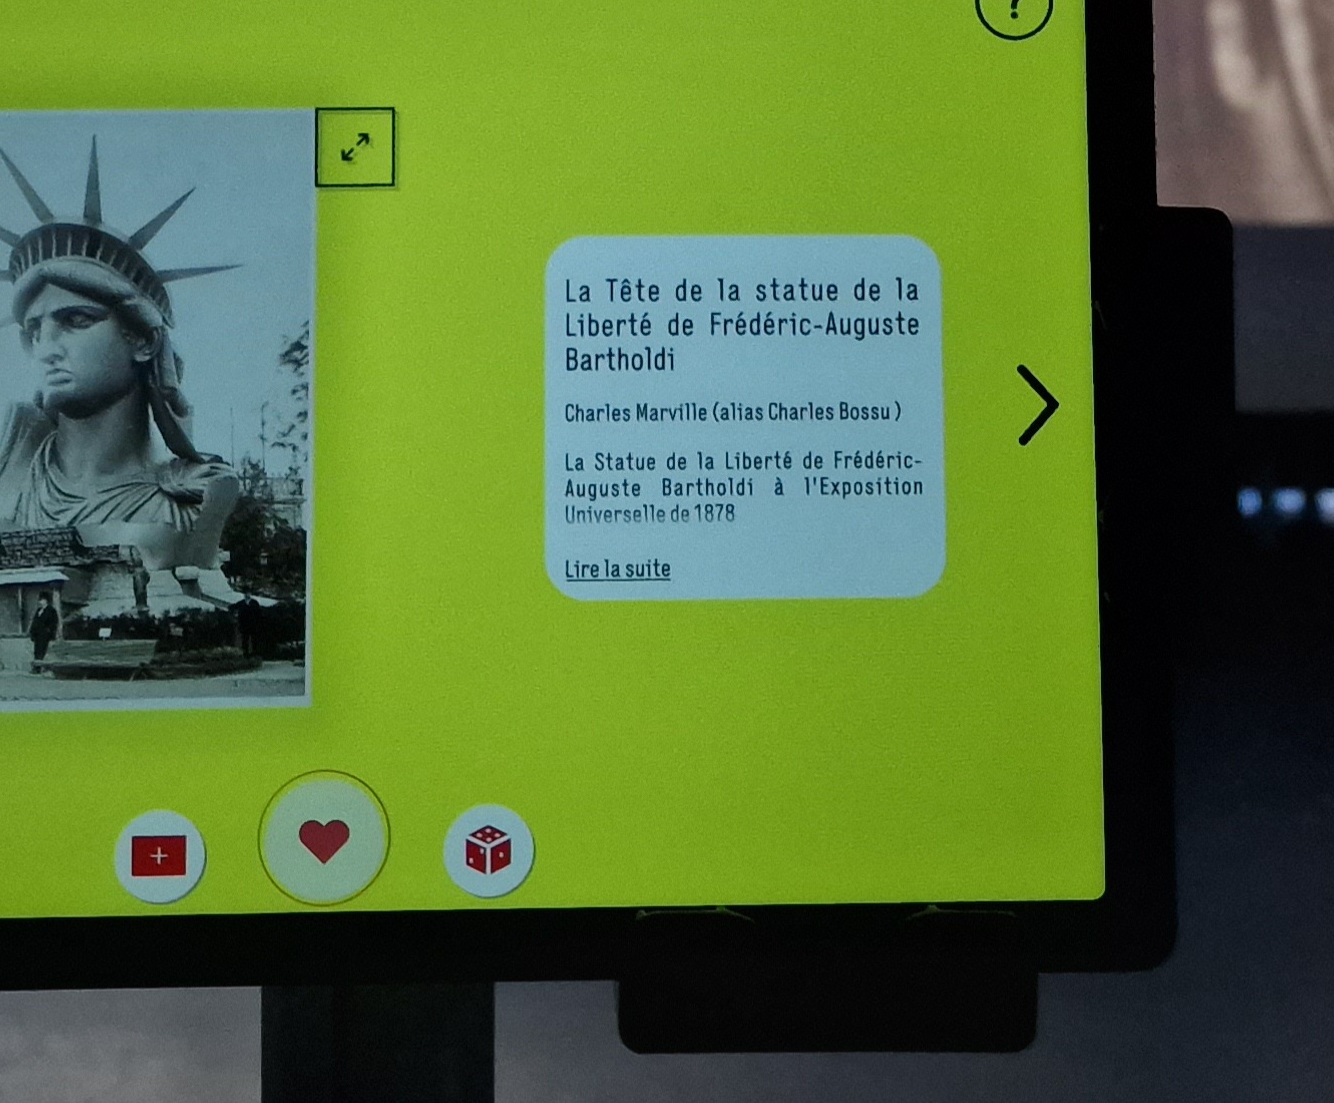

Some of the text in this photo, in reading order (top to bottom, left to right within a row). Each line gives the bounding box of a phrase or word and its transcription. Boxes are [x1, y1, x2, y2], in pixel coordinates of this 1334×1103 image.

[565, 275, 920, 304] La Tête de la statue de la
[565, 310, 920, 342] Liberté de Frédéric-Auguste
[565, 346, 675, 373] Bartholdi
[564, 402, 631, 424] Charles
[635, 401, 708, 423] Marville
[712, 400, 764, 424] (alias
[768, 401, 835, 423] Charles
[564, 449, 923, 473] La Statue de la Liberté de Frédéric-
[564, 476, 924, 503] Auguste Bartholdi à l'Exposition
[564, 502, 736, 525] Universelle de 1878
[565, 557, 672, 580] Lire la suite
